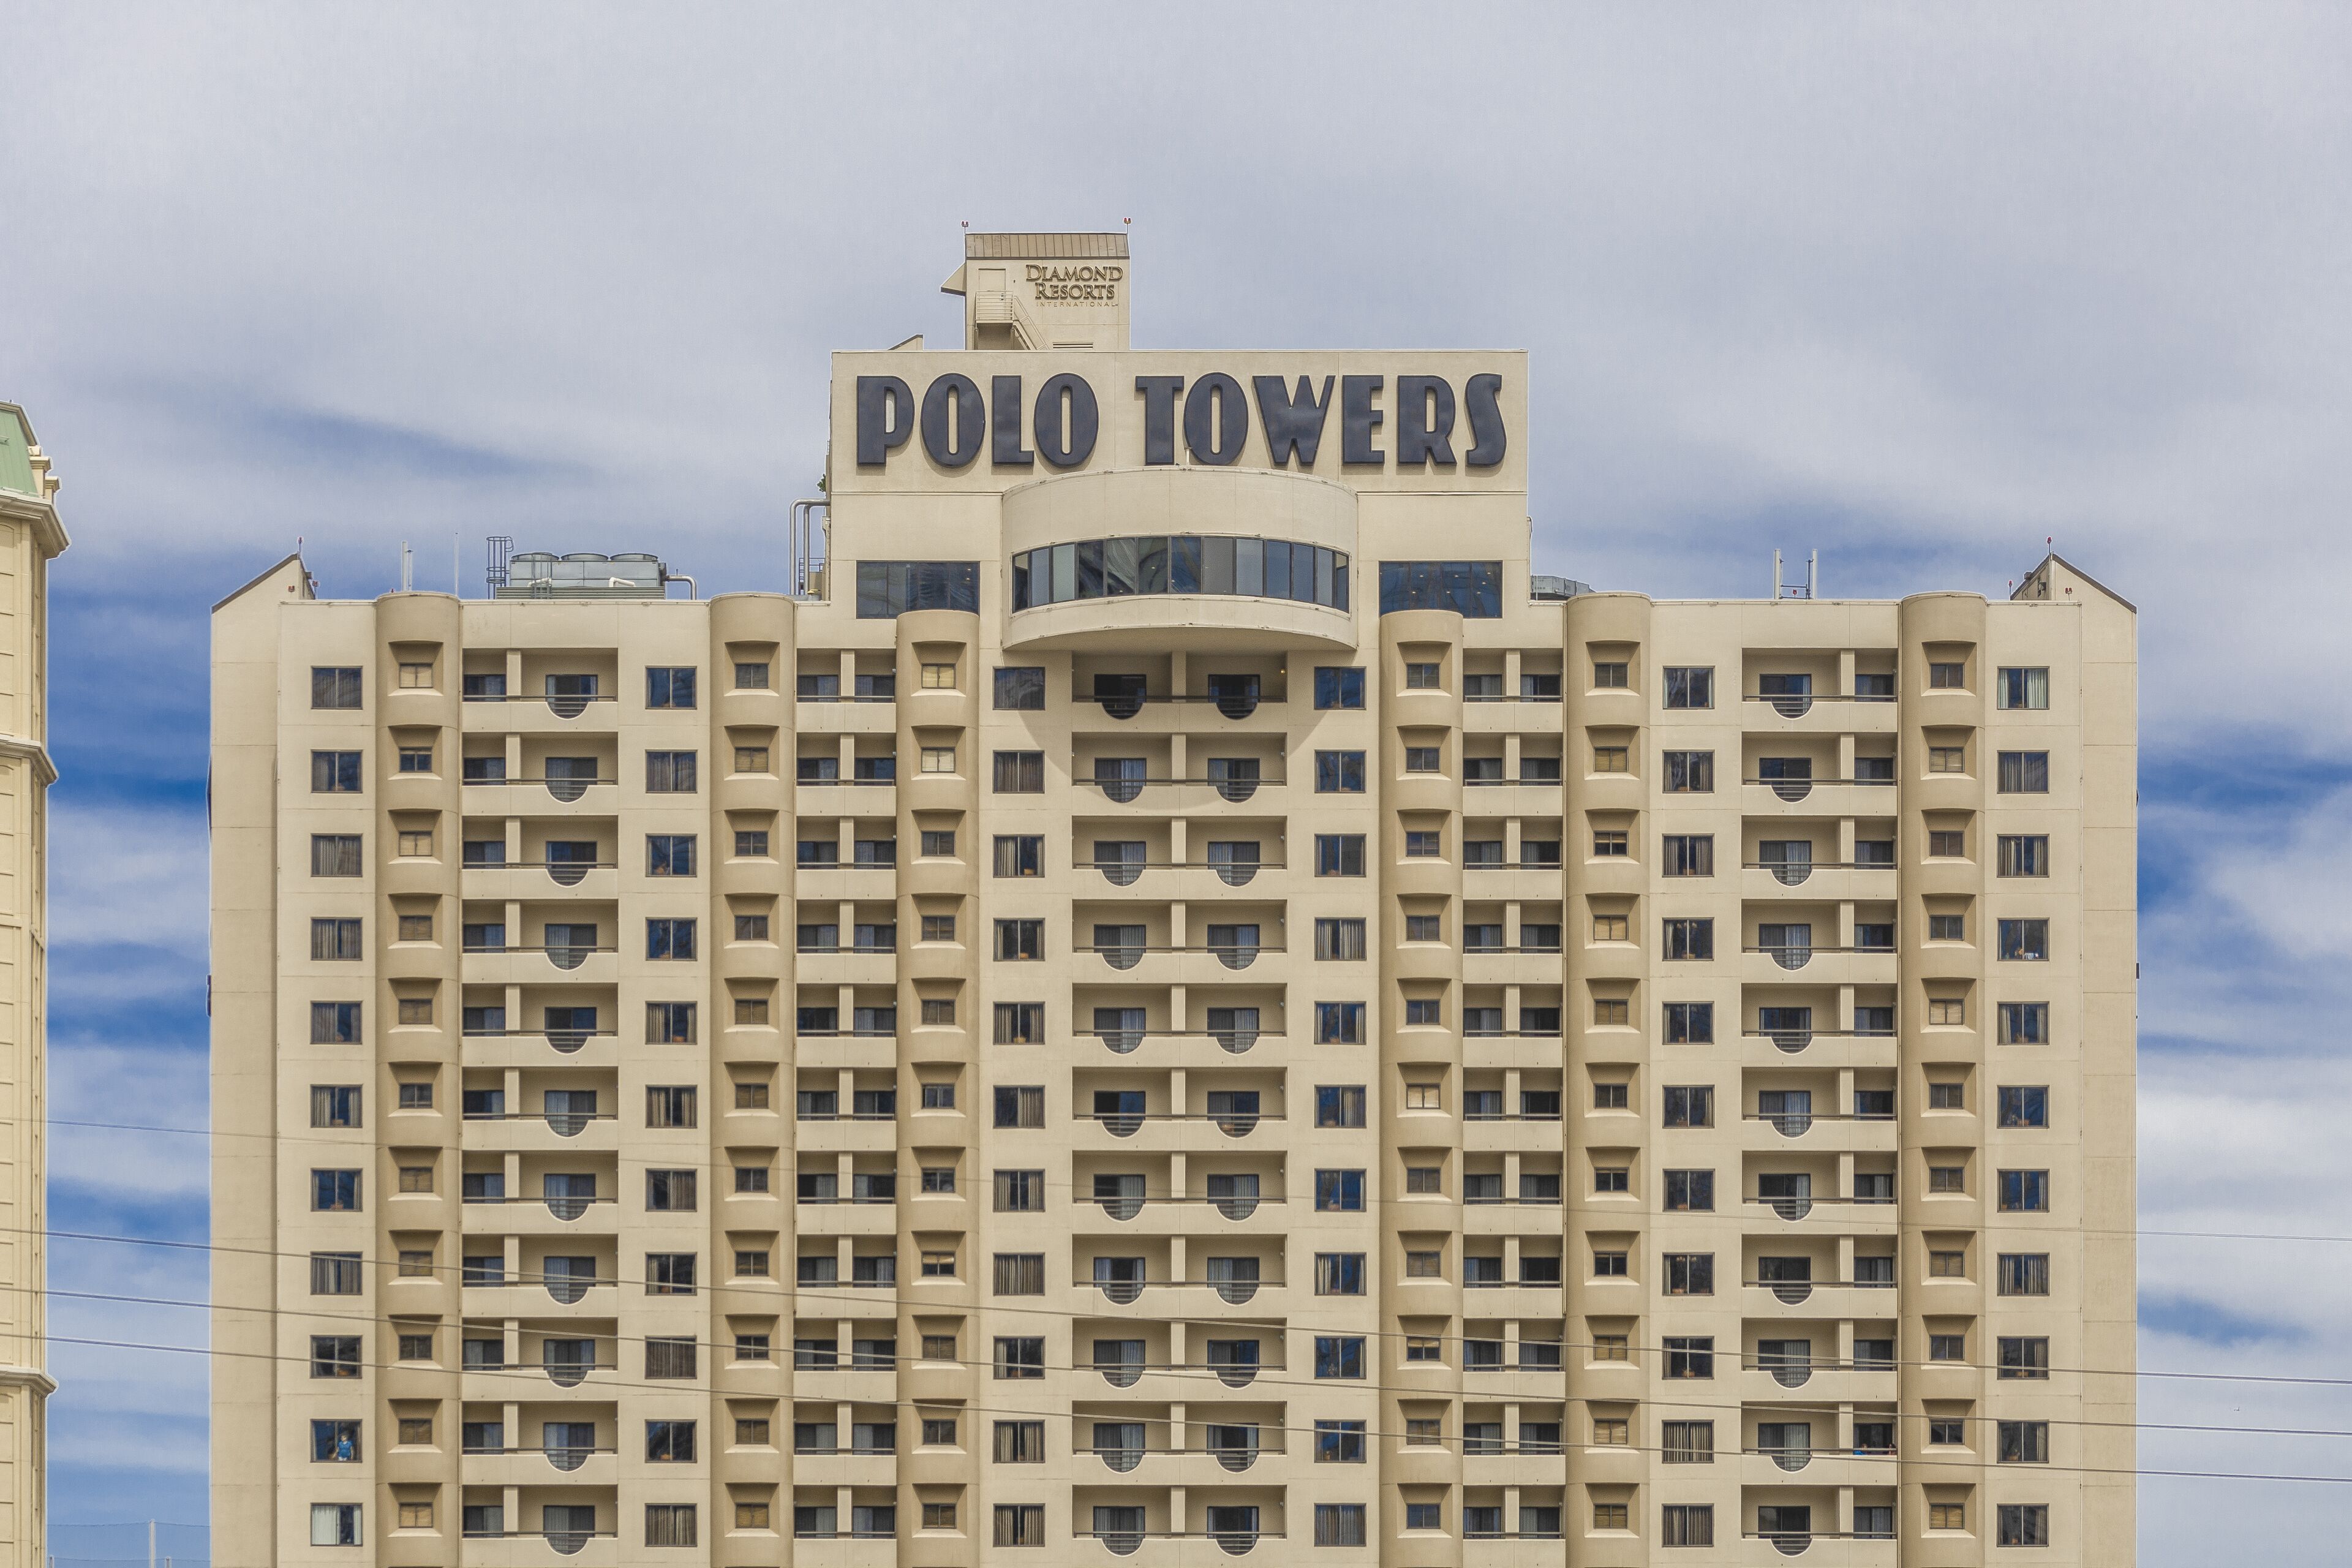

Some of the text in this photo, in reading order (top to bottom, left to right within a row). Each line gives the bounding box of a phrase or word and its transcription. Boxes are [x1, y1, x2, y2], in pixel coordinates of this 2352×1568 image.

[1026, 264, 1123, 282] DIAMOND
[1035, 282, 1115, 300] RESORTS
[857, 372, 1507, 467] POLO TOWERS
